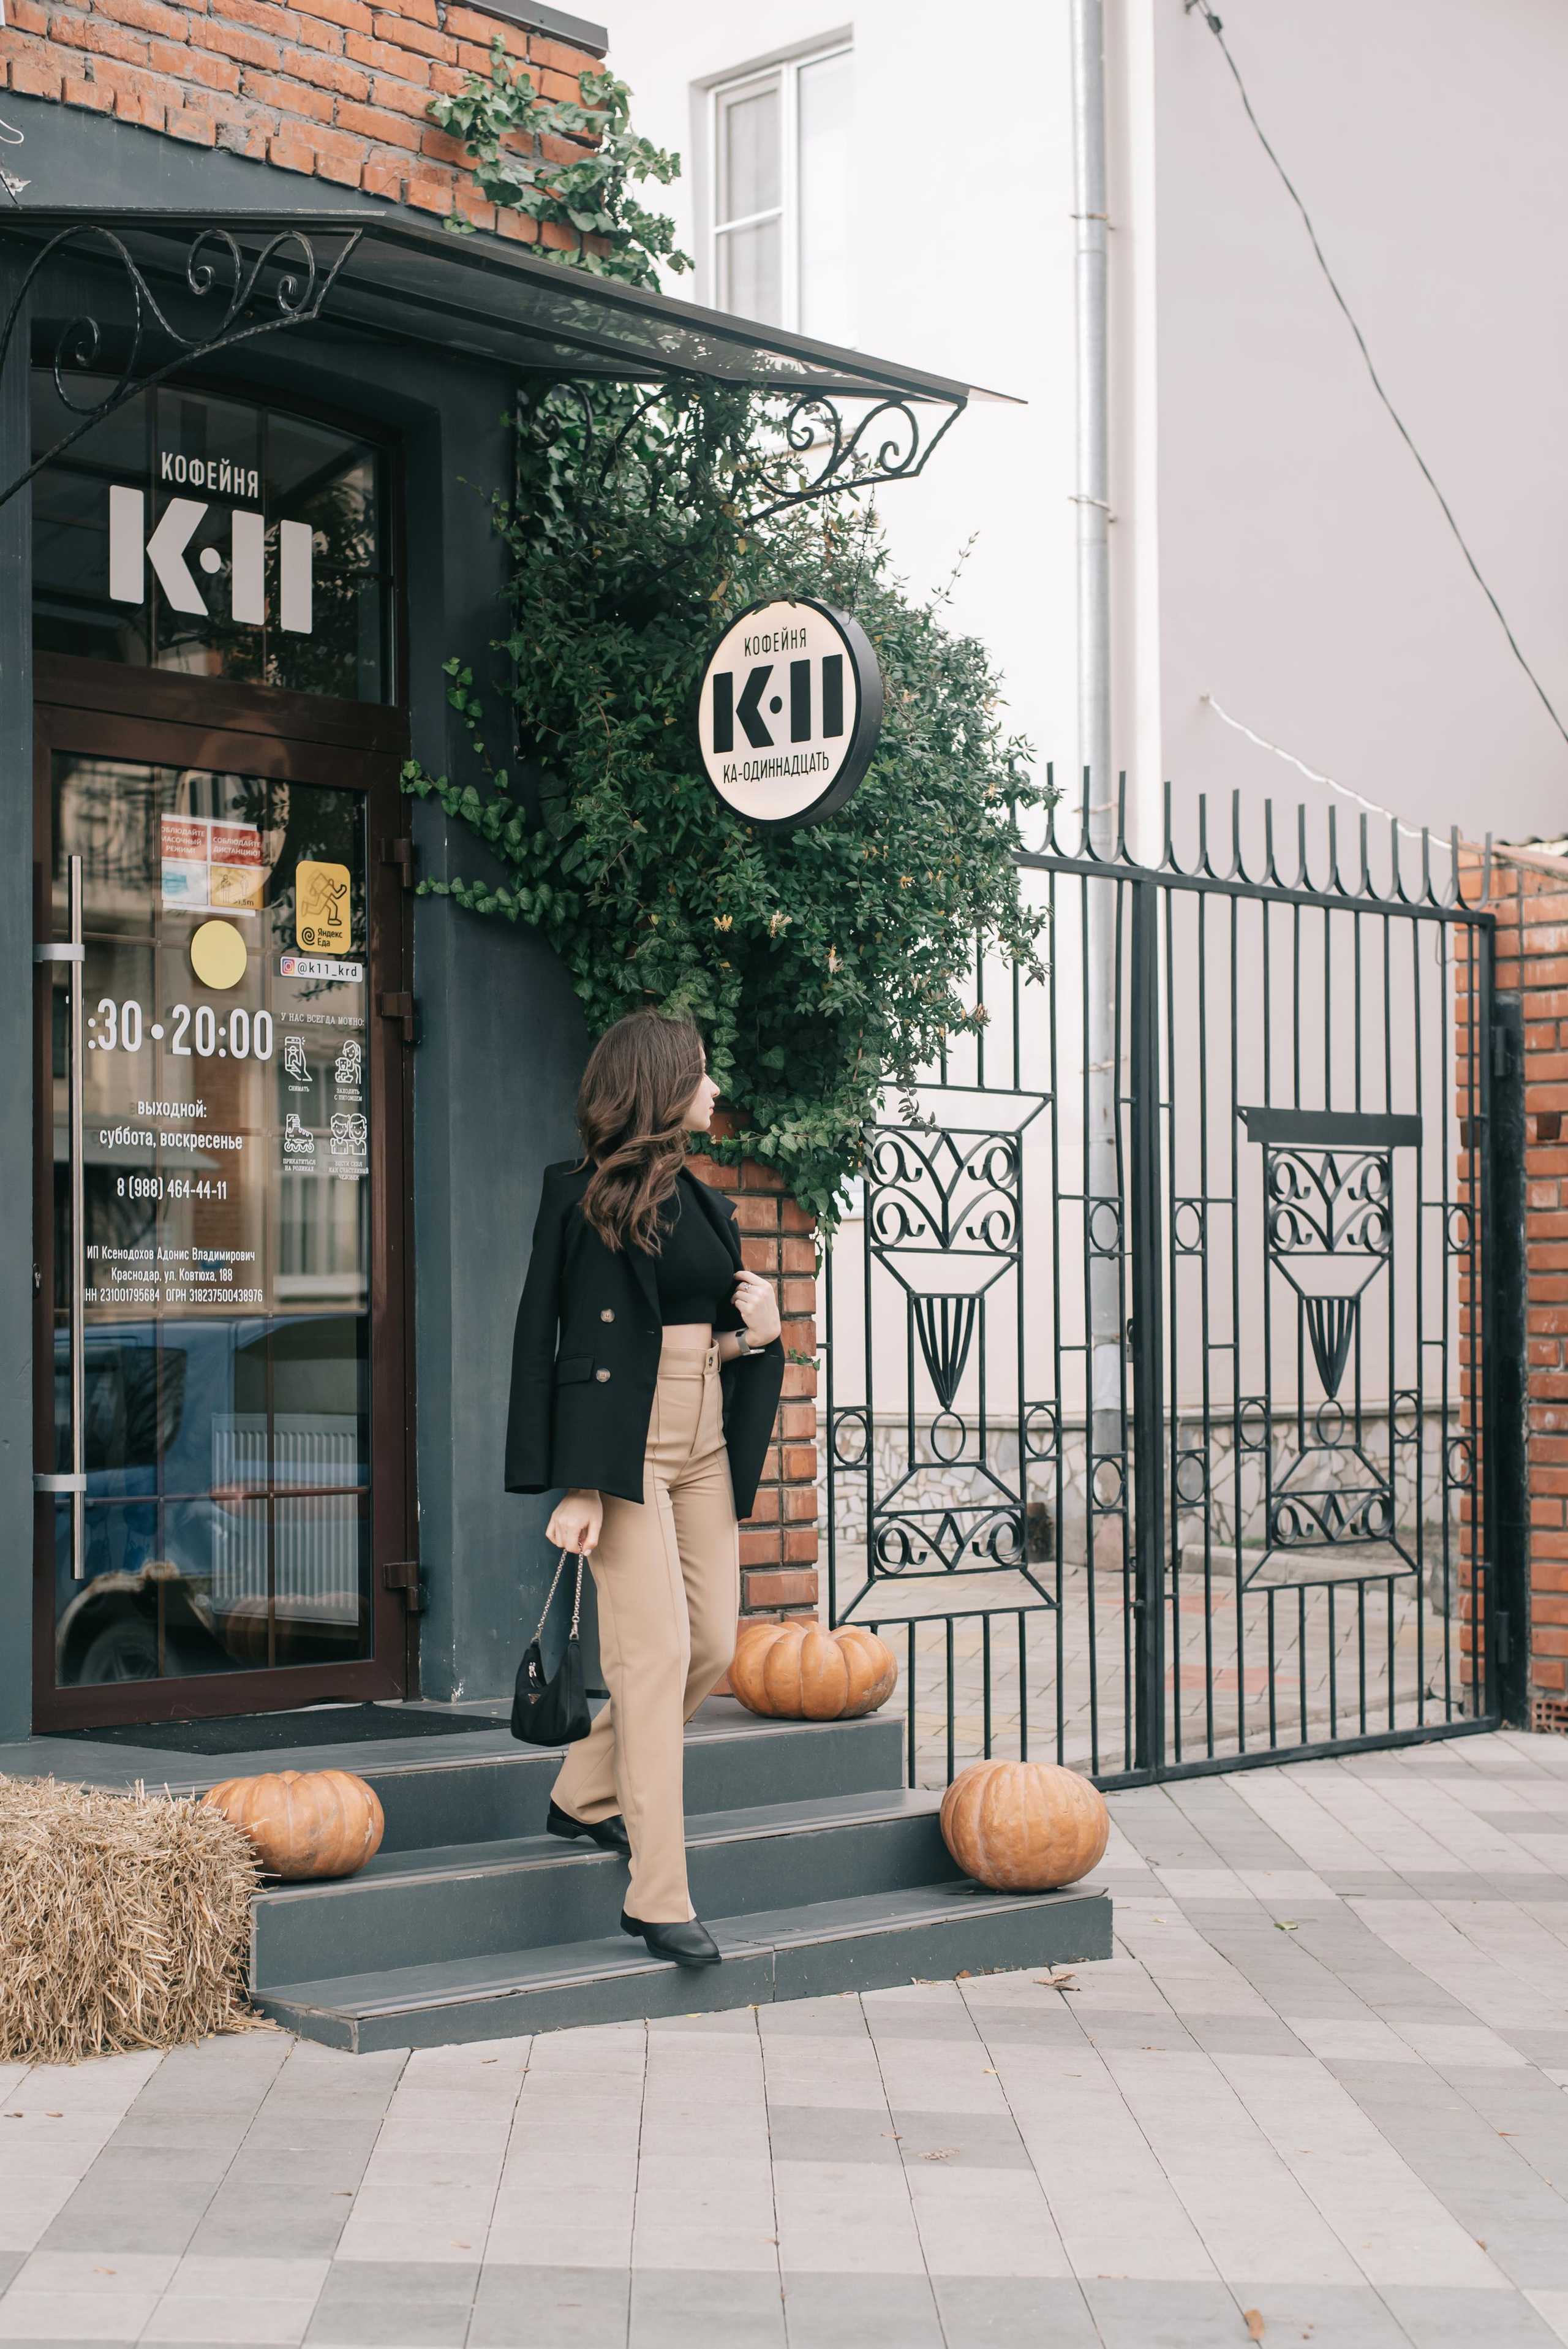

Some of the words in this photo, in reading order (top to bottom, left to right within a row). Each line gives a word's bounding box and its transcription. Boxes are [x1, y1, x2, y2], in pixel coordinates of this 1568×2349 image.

[162, 452, 258, 498] КОФЕЙНЯ
[744, 626, 806, 657] КОФЕЙНЯ
[723, 751, 829, 784] КА-ОДИННАДЦАТЬ
[161, 826, 205, 837] ОБЛЮДАЙТЕ
[165, 844, 195, 854] РЕЖИМ!
[213, 836, 261, 848] СОБЛЮДАЙТЕ
[213, 846, 260, 857] ДИСТАНЦИЮ!
[317, 928, 343, 939] Яндекс
[317, 937, 331, 947] Еда
[298, 961, 357, 977] @k11_krd
[281, 1012, 287, 1021] У
[288, 1013, 304, 1023] НАС
[306, 1014, 336, 1025] ВСЕГДА
[337, 1016, 364, 1026] МОЖНО:
[172, 1004, 273, 1061] 20:00
[99, 1126, 156, 1149] суббота,
[160, 1132, 243, 1152] воскресенье
[117, 1177, 124, 1197] 8
[129, 1176, 164, 1200] (988)
[167, 1179, 227, 1200] 464-44-11
[87, 1245, 99, 1260] ИП
[102, 1246, 154, 1261] Ксенодохов
[157, 1246, 189, 1262] Адонис
[192, 1247, 255, 1264] Владимирович
[111, 1266, 162, 1284] Краснодар,
[164, 1271, 176, 1284] ул.
[179, 1268, 217, 1282] Ковтюха,
[219, 1268, 233, 1282] 188
[83, 1288, 97, 1302] НН
[100, 1288, 160, 1302] 231001795684
[166, 1288, 186, 1303] ОГРН
[189, 1288, 263, 1303] 318237500438976
